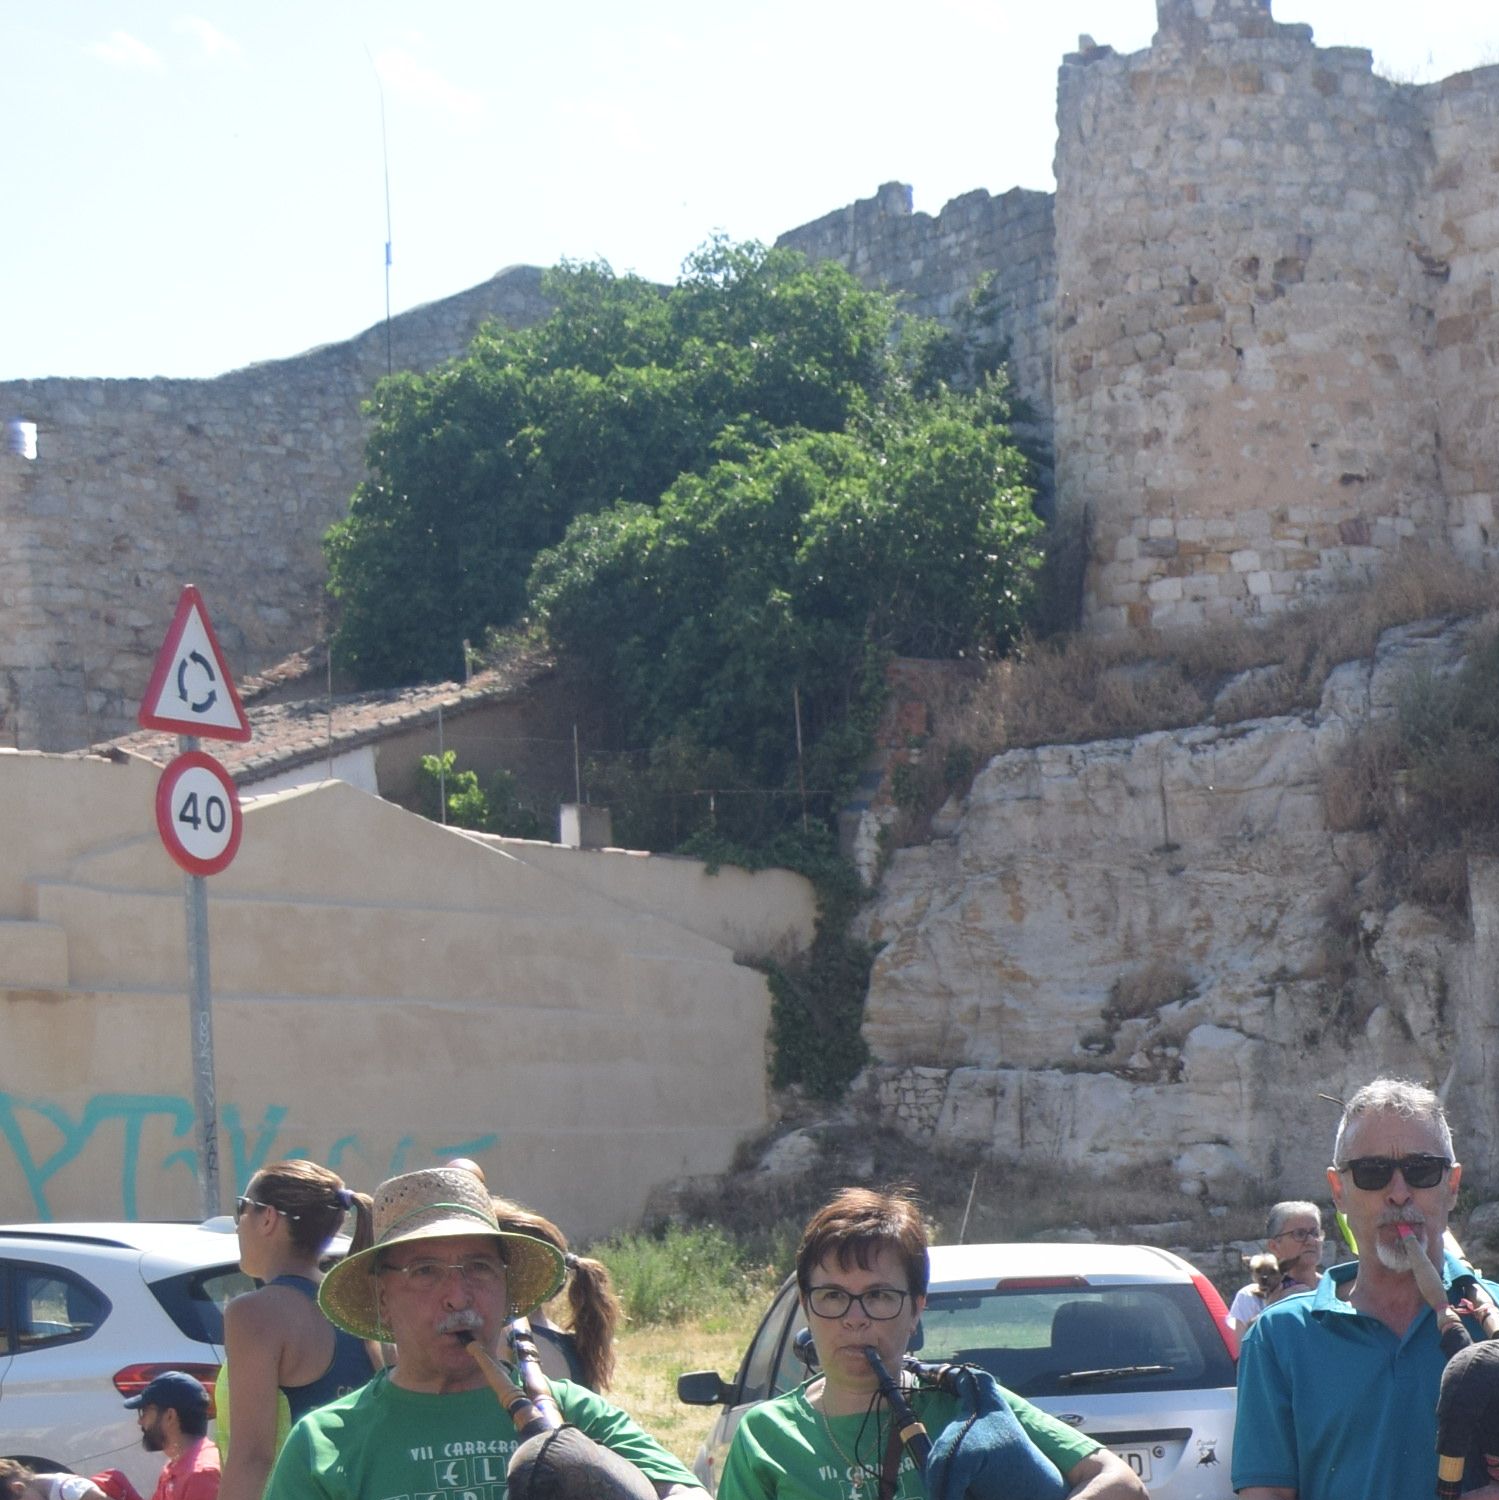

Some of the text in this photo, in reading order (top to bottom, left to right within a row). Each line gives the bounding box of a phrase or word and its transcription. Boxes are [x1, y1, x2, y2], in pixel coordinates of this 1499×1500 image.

[179, 792, 226, 833] 40
[411, 1440, 519, 1461] VII CARRERA
[846, 1457, 915, 1481] CARRRA
